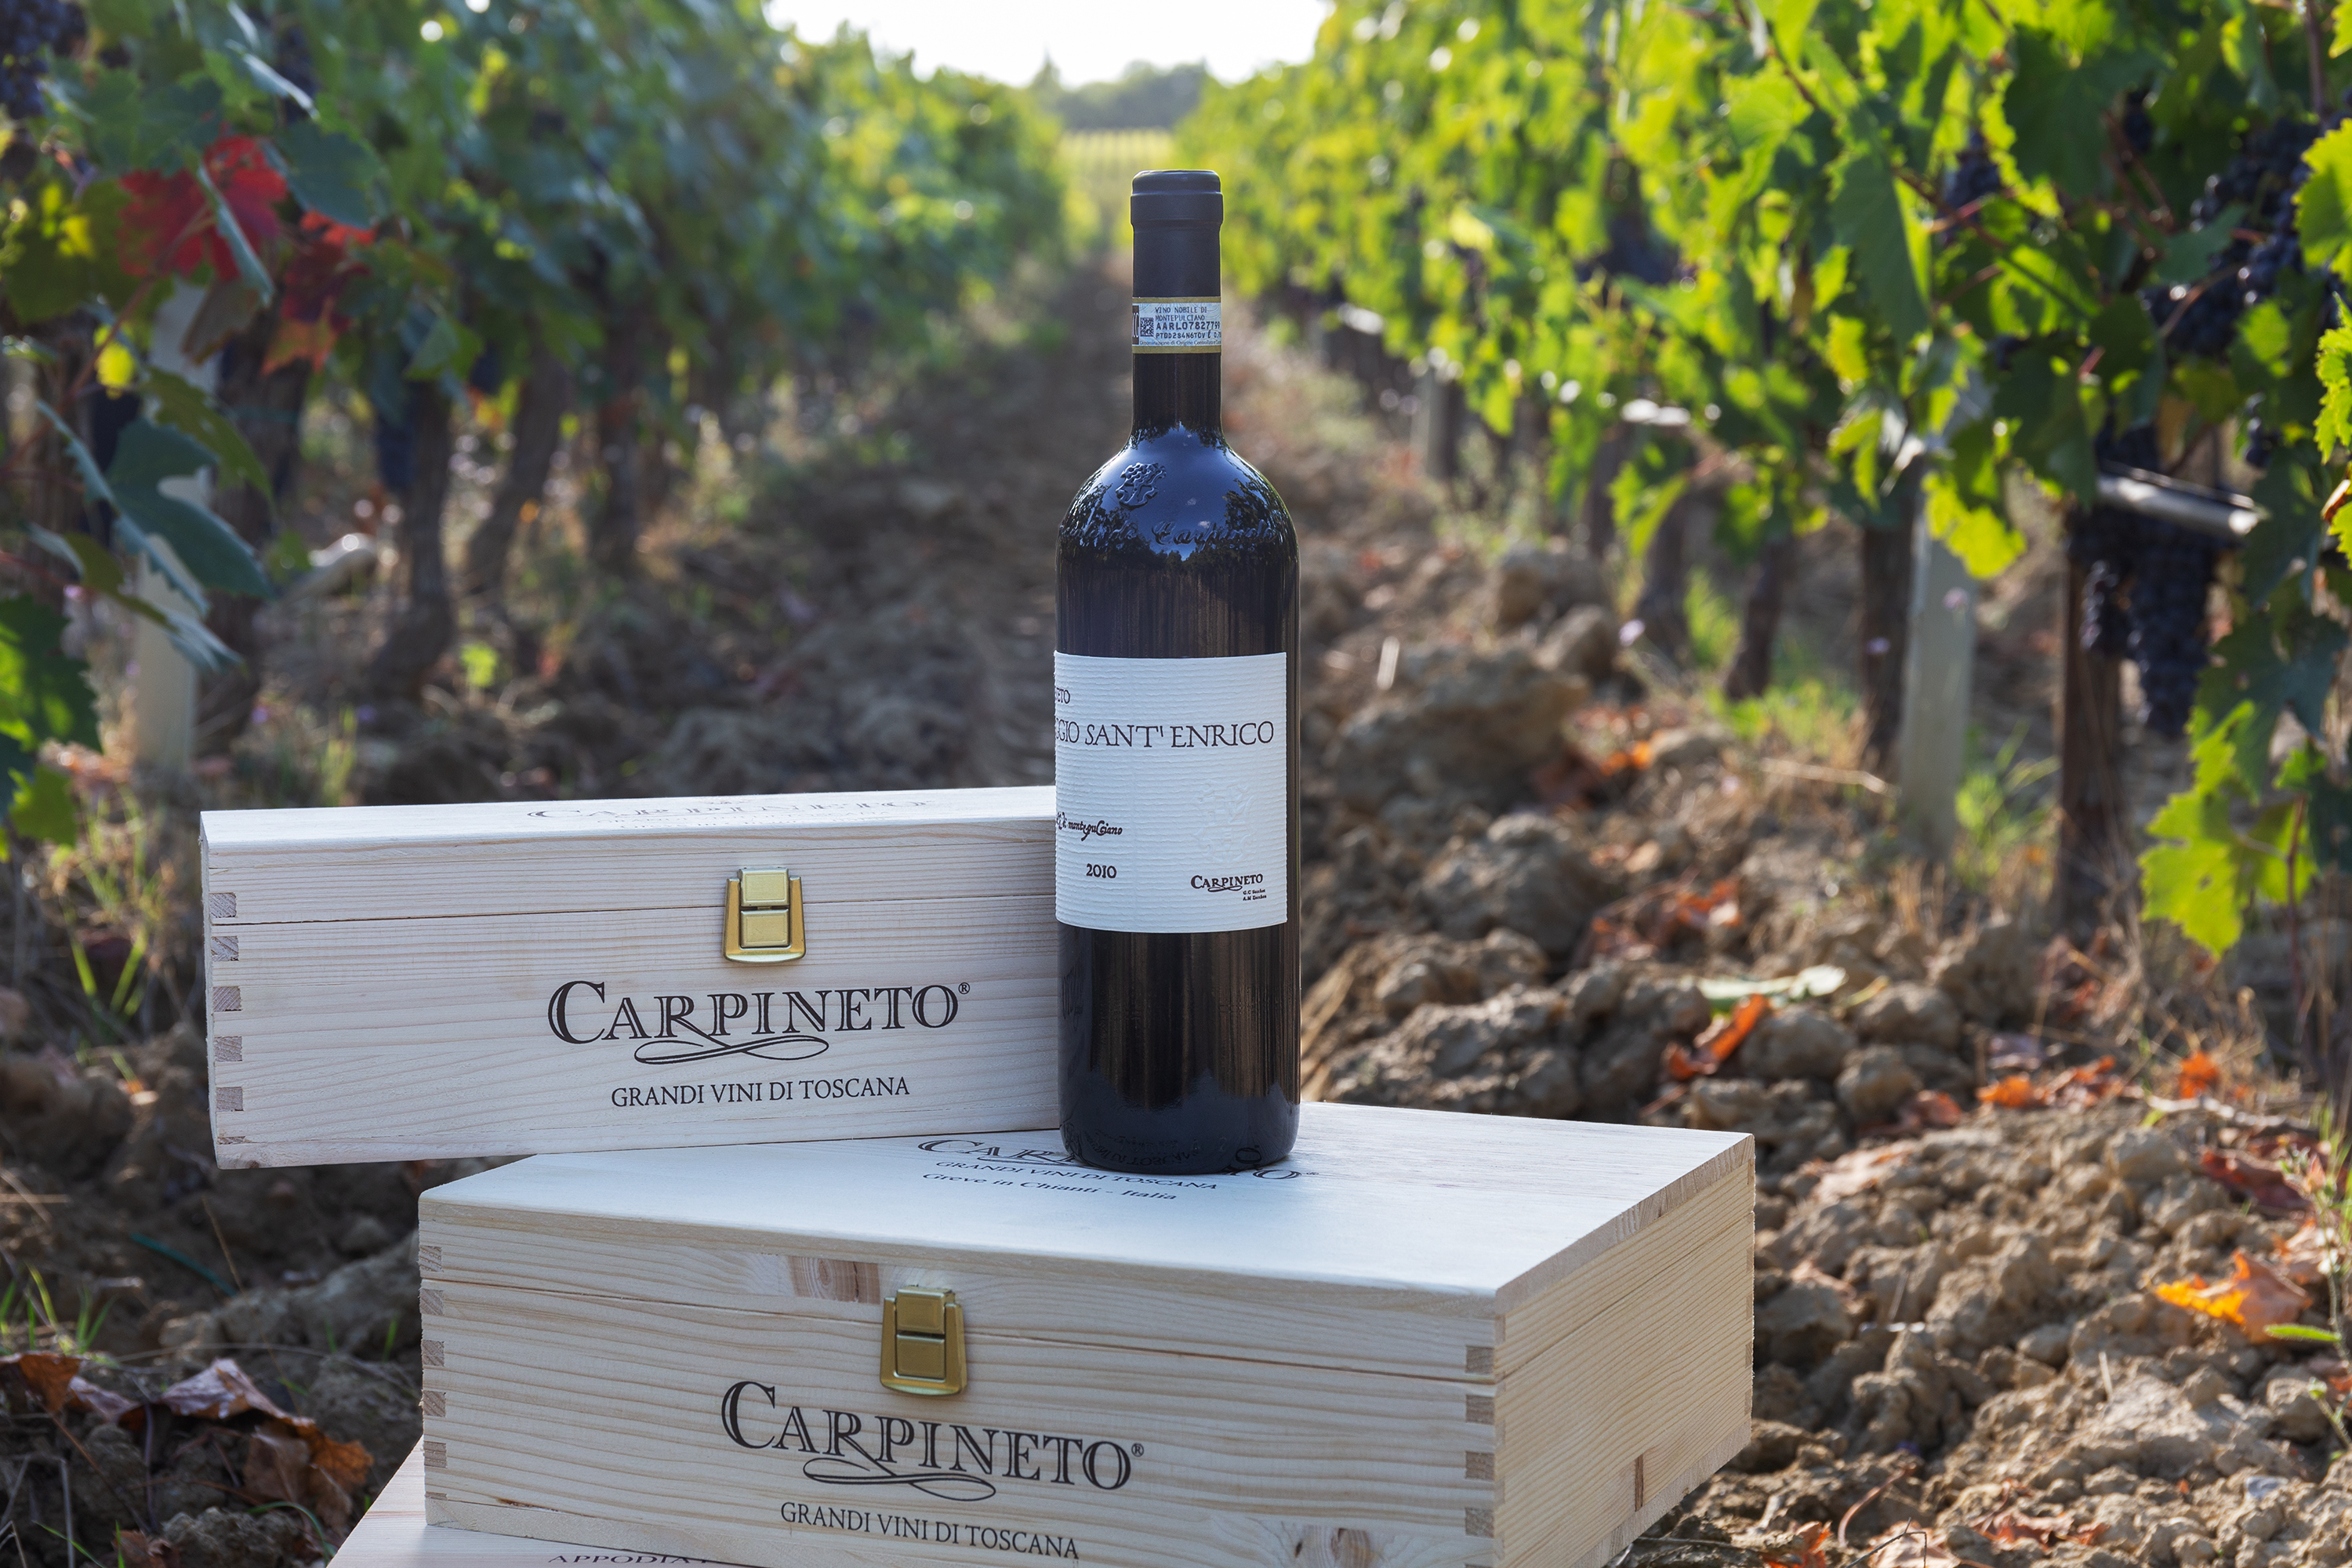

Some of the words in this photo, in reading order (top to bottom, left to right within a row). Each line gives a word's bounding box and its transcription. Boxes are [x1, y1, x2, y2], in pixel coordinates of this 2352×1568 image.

[1055, 687, 1071, 704] ETO
[1085, 724, 1164, 748] SANT'
[1170, 720, 1275, 748] ENRICO
[1086, 863, 1117, 879] 2010
[1190, 873, 1264, 892] CARPINETO
[612, 1084, 704, 1107] GRANDI
[710, 1083, 763, 1103] VINI
[769, 1081, 793, 1101] DI
[799, 1076, 910, 1099] TOSCANA
[923, 1173, 987, 1184] Greve
[1020, 1181, 1102, 1192] Chianti
[1120, 1190, 1177, 1200] Italia
[936, 1161, 1026, 1173] GRANDI
[1029, 1168, 1080, 1177] VINI
[1112, 1176, 1217, 1189] TOSCANA
[781, 1501, 871, 1533] GRANDI
[877, 1514, 928, 1541] VINI
[935, 1522, 960, 1544] DI
[965, 1525, 1080, 1559] TOSCANA
[548, 1555, 707, 1564] APPODIA
